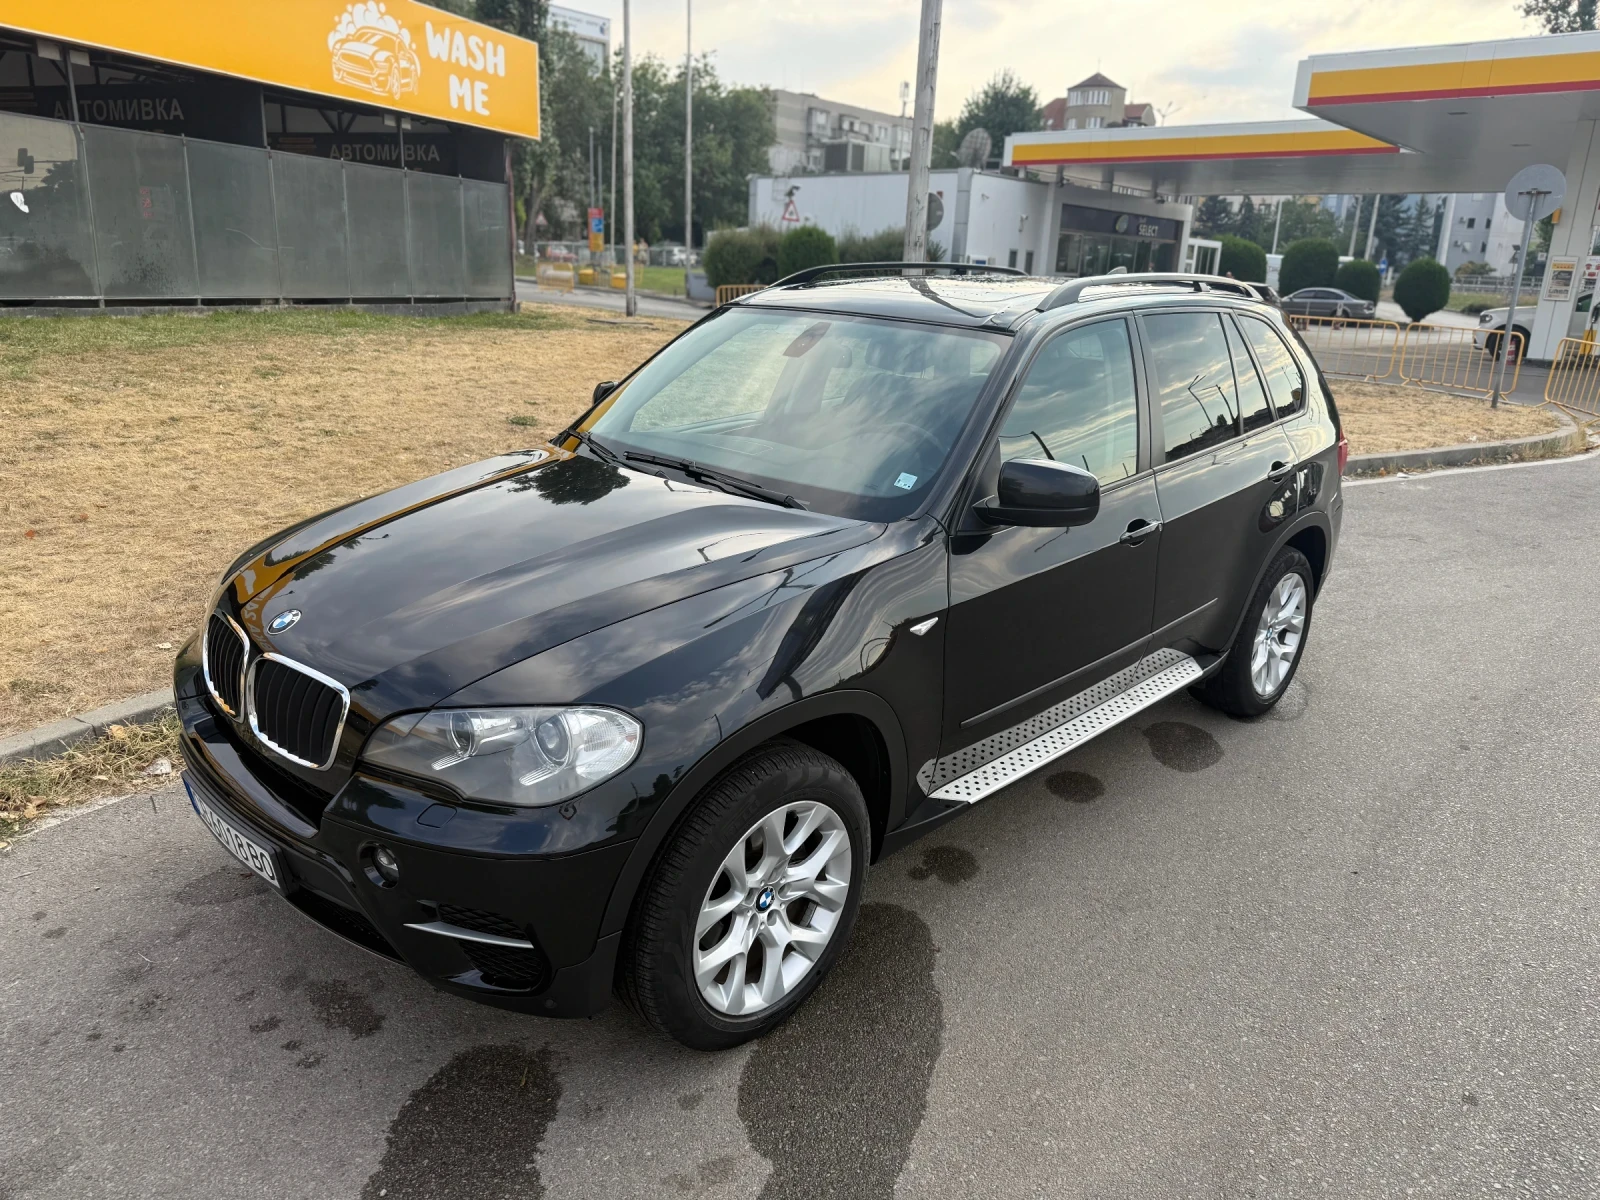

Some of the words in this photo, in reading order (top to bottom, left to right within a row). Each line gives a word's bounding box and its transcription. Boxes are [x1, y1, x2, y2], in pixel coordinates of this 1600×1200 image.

[425, 20, 505, 77] WASH
[449, 73, 490, 116] ME
[1138, 223, 1159, 237] SELECT
